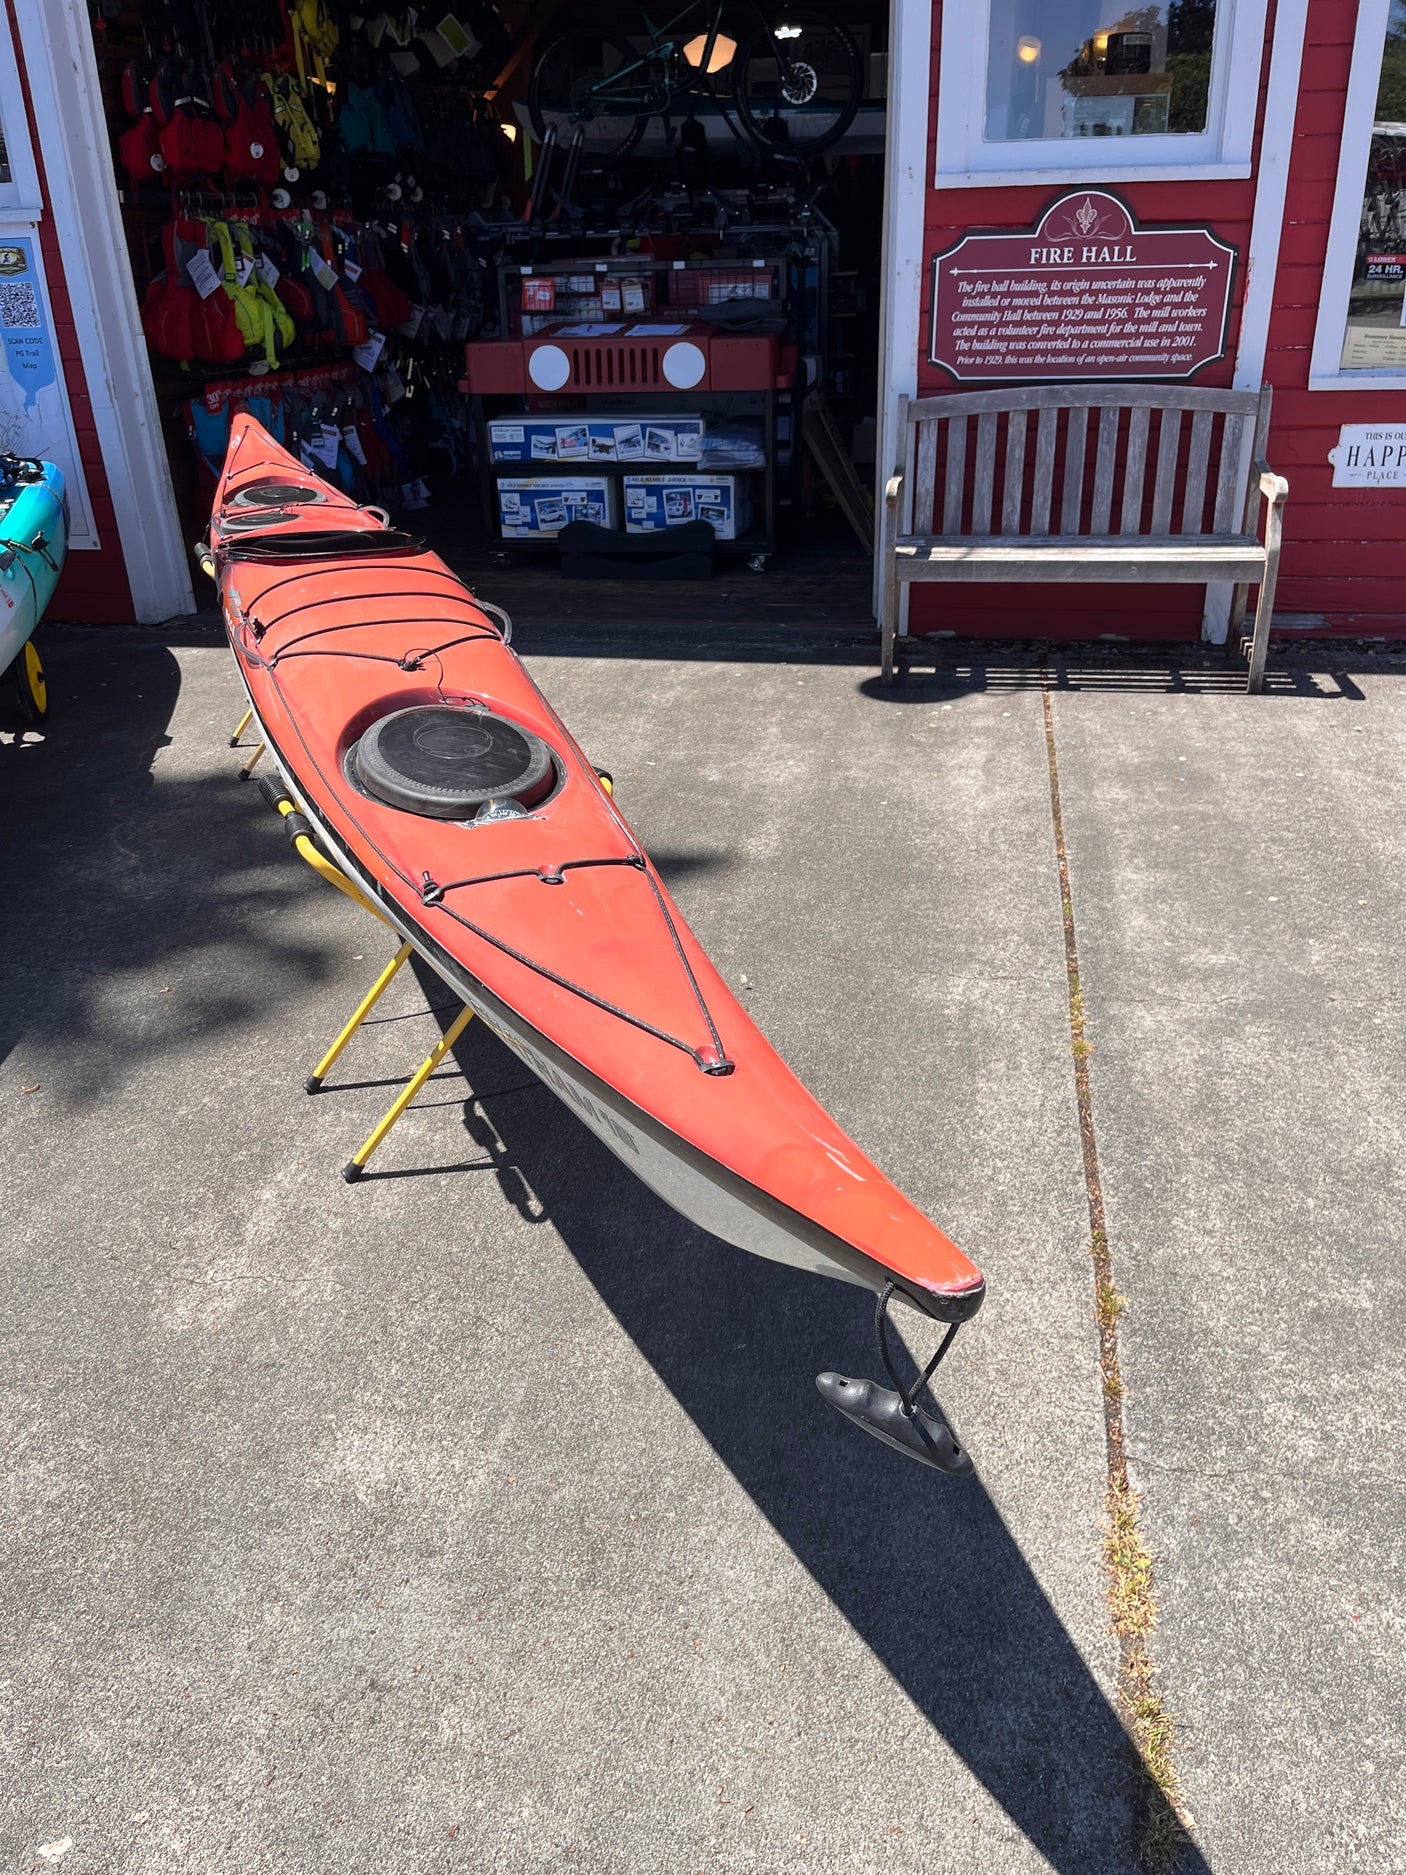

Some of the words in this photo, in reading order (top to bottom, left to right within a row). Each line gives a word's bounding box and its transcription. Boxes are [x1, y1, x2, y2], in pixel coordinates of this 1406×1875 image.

[1029, 247, 1074, 264] FIRE
[1081, 245, 1137, 263] HALL
[1368, 264, 1382, 273] 24
[1385, 264, 1404, 273] HR.
[958, 281, 972, 293] The
[971, 281, 990, 295] fire
[991, 280, 1010, 292] hall
[1010, 280, 1048, 293] building,
[1050, 280, 1062, 290] its
[1063, 279, 1090, 293] origin
[1091, 278, 1136, 289] uncertain
[1137, 280, 1156, 288] was
[1156, 275, 1206, 291] apparently
[962, 296, 1001, 307] installed
[1001, 298, 1011, 306] or
[1012, 295, 1043, 306] moved
[1043, 294, 1080, 305] between
[1080, 293, 1096, 304] the
[1096, 293, 1135, 304] Masonic
[1135, 291, 1163, 306] Lodge
[1163, 291, 1183, 302] and
[1184, 291, 1199, 302] the
[951, 311, 1001, 324] Community
[1002, 310, 1023, 321] Hall
[1023, 309, 1059, 320] between
[1060, 309, 1084, 320] 1929
[1084, 307, 1105, 319] and
[1105, 307, 1128, 319] 1956.
[1133, 307, 1151, 318] The
[1151, 306, 1171, 317] mill
[1171, 306, 1207, 317] workers
[953, 325, 978, 336] acted
[978, 328, 989, 336] as
[989, 328, 997, 336] a
[998, 324, 1039, 336] volunteer
[1036, 323, 1055, 338] fire
[1056, 323, 1108, 337] department
[1106, 322, 1123, 336] for
[1123, 322, 1138, 333] the
[1139, 321, 1158, 333] mill
[1159, 321, 1179, 332] and
[1178, 322, 1203, 332] town.
[955, 339, 971, 351] The
[971, 339, 1007, 352] building
[1008, 341, 1026, 350] was
[1027, 338, 1070, 349] converted
[1071, 339, 1081, 349] to
[1081, 340, 1089, 348] a
[1089, 336, 1144, 348] commercial
[1143, 338, 1159, 347] use
[1160, 337, 1171, 347] in
[1171, 336, 1197, 347] 2001.
[22, 362, 38, 370] Map
[956, 355, 975, 365] Prior
[975, 356, 983, 364] to
[984, 355, 1003, 365] 1929,
[1004, 354, 1018, 364] this
[1034, 354, 1046, 363] the
[1046, 354, 1075, 363] location
[1076, 353, 1087, 365] of
[1096, 354, 1129, 365] open-air
[1128, 353, 1170, 364] community
[1170, 353, 1193, 363] space.
[1365, 432, 1384, 440] THIS
[1385, 432, 1393, 440] IS
[1346, 445, 1406, 467] HAPP
[1366, 471, 1399, 480] PLACE
